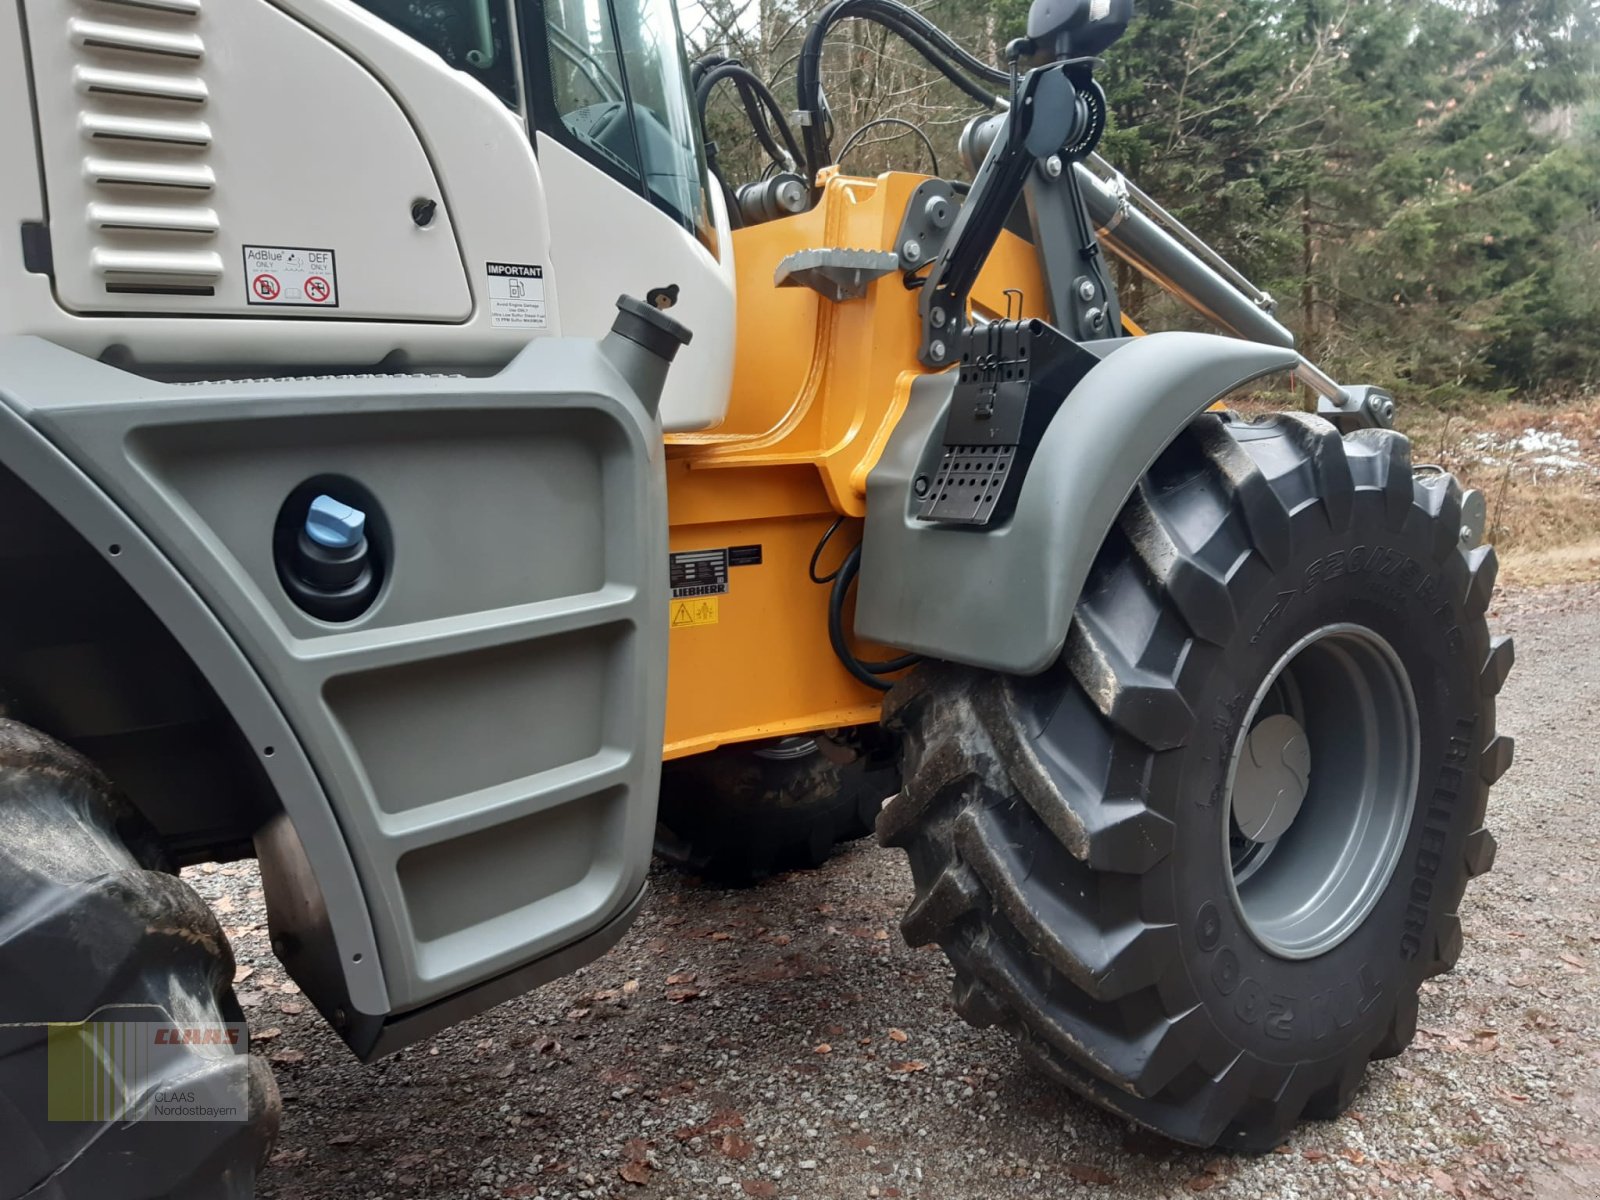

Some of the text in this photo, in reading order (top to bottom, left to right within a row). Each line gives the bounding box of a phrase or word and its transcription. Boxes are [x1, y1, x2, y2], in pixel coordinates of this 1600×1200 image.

[308, 252, 329, 263] DEF
[488, 264, 542, 276] IMPORTANT
[673, 584, 725, 597] LIEBHERR
